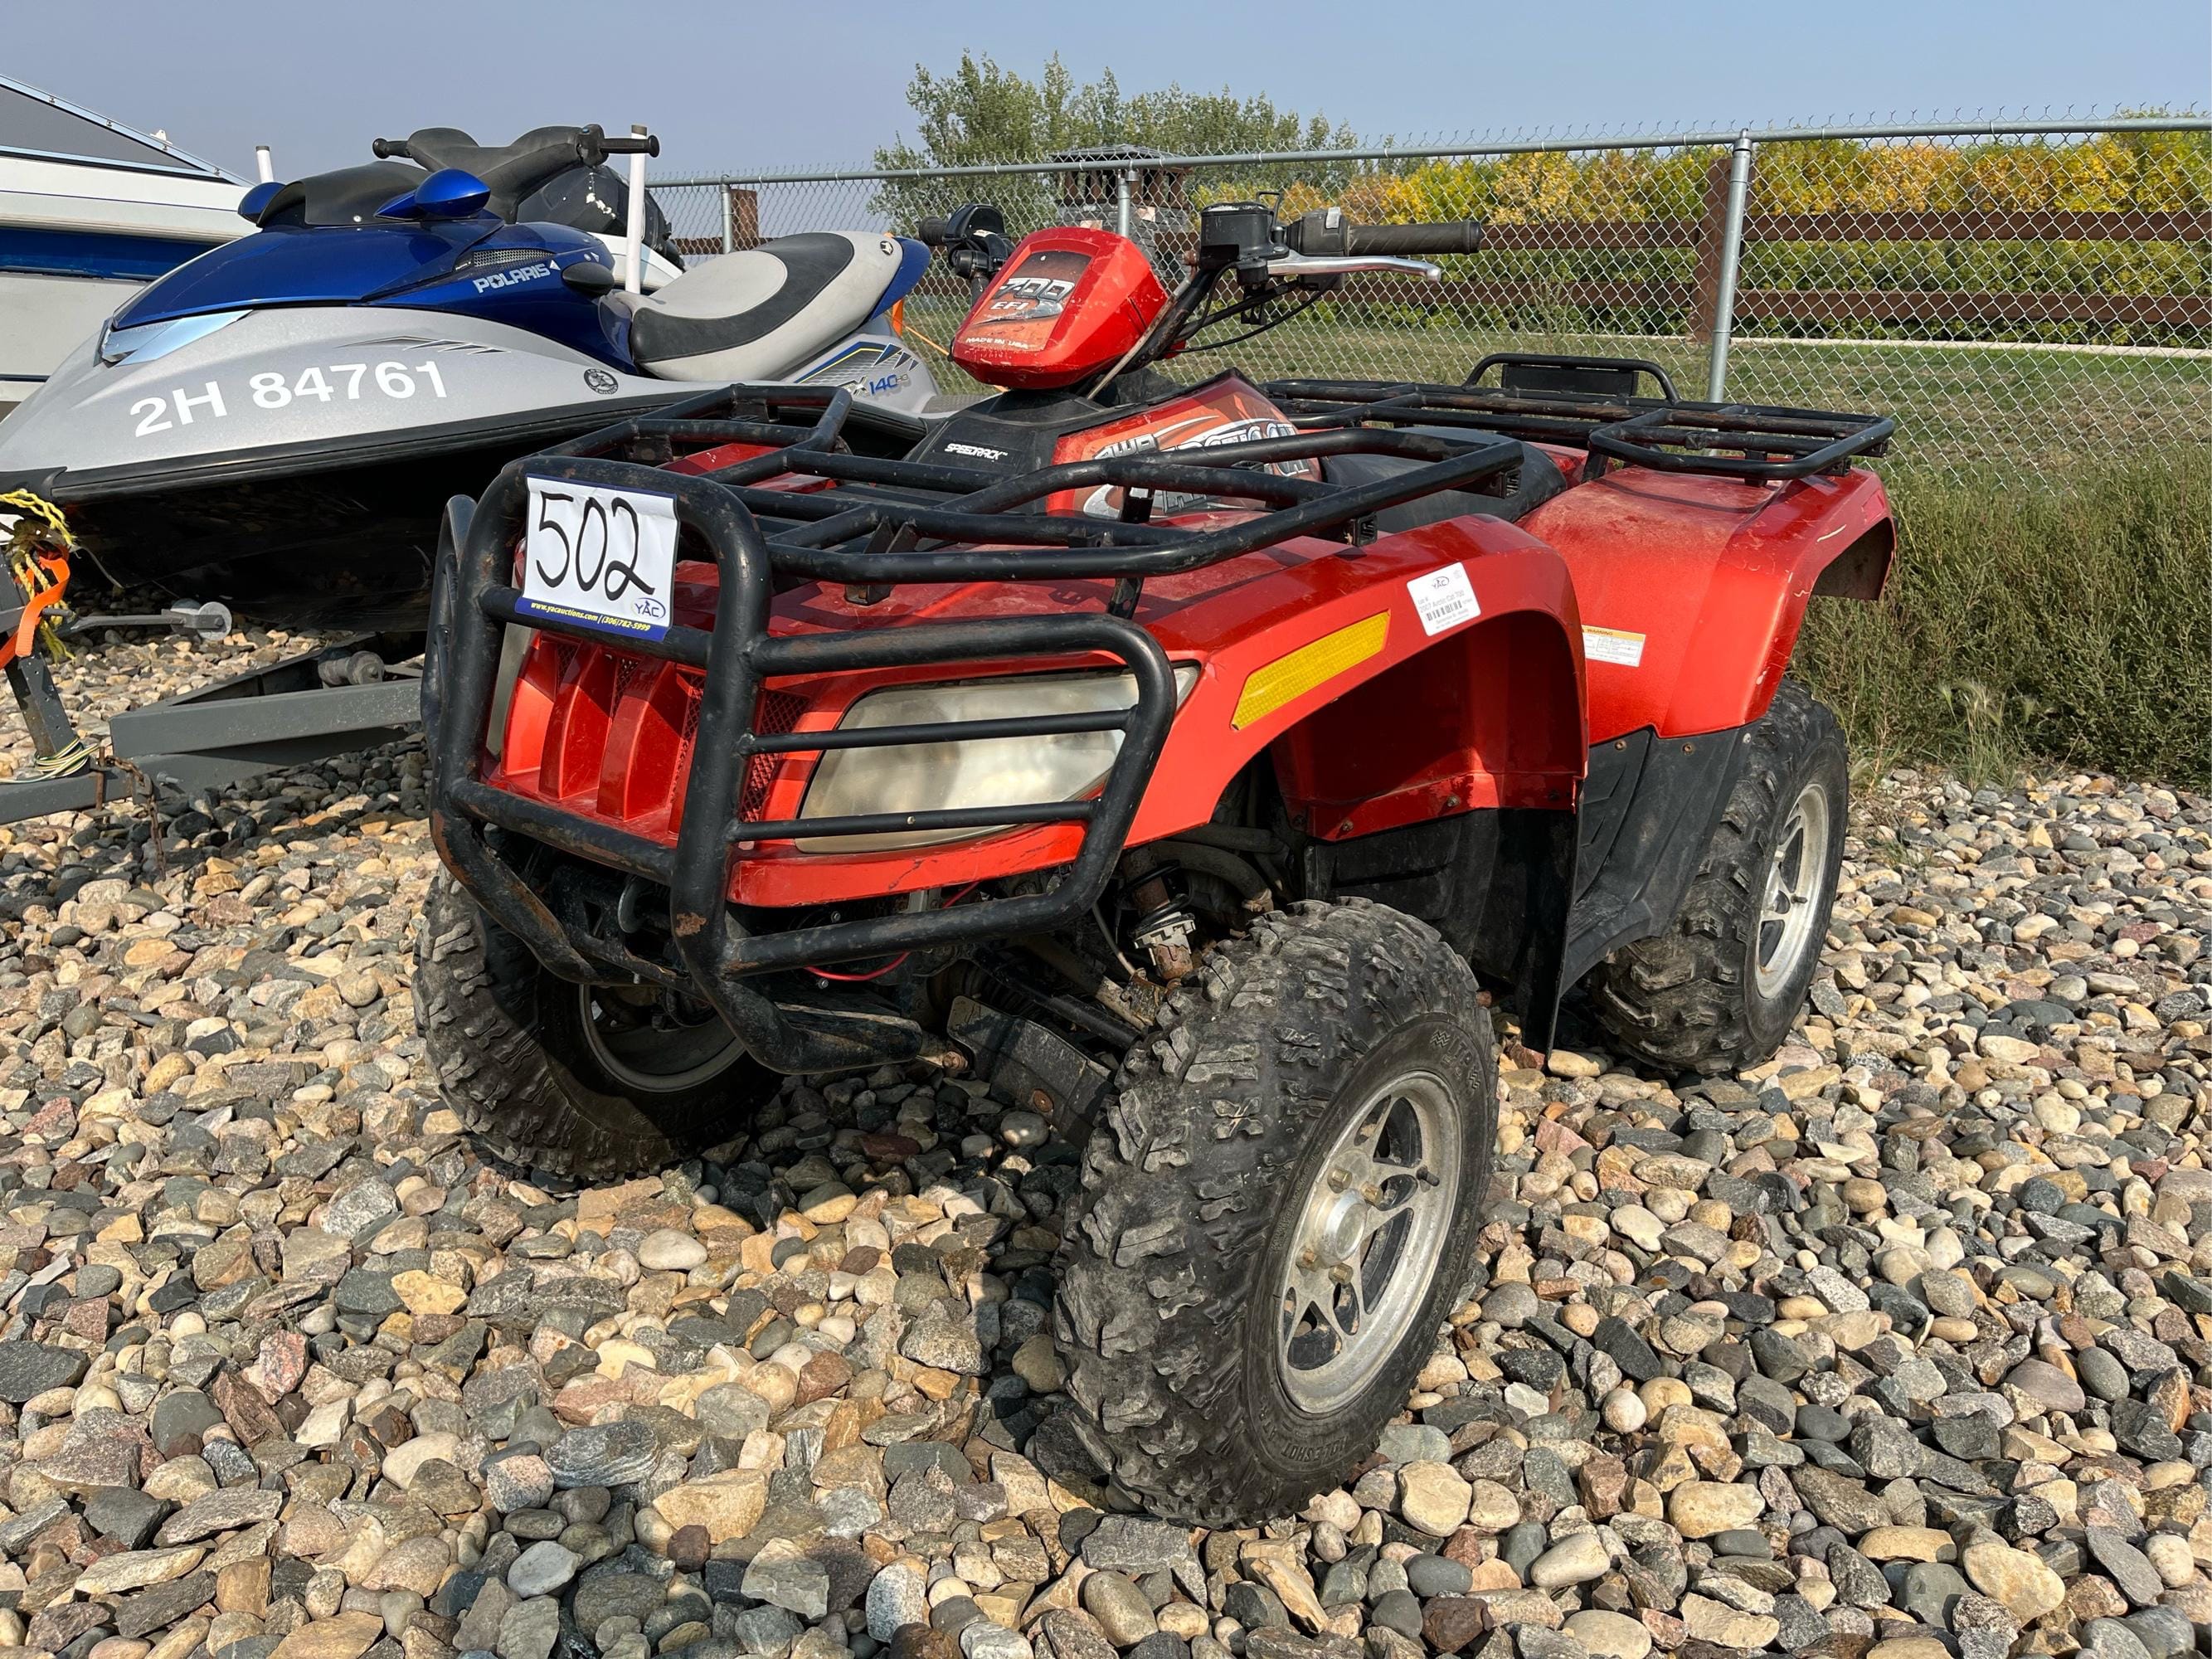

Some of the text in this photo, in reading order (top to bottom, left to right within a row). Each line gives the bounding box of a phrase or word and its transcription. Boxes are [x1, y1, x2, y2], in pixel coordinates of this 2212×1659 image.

[473, 263, 551, 293] POLARIS
[992, 277, 1076, 303] 700
[990, 301, 1029, 310] EFI
[129, 360, 447, 437] 2H 84761
[536, 490, 655, 601] 502
[530, 601, 598, 622] www.yacauctions.com
[634, 601, 660, 618] YAC
